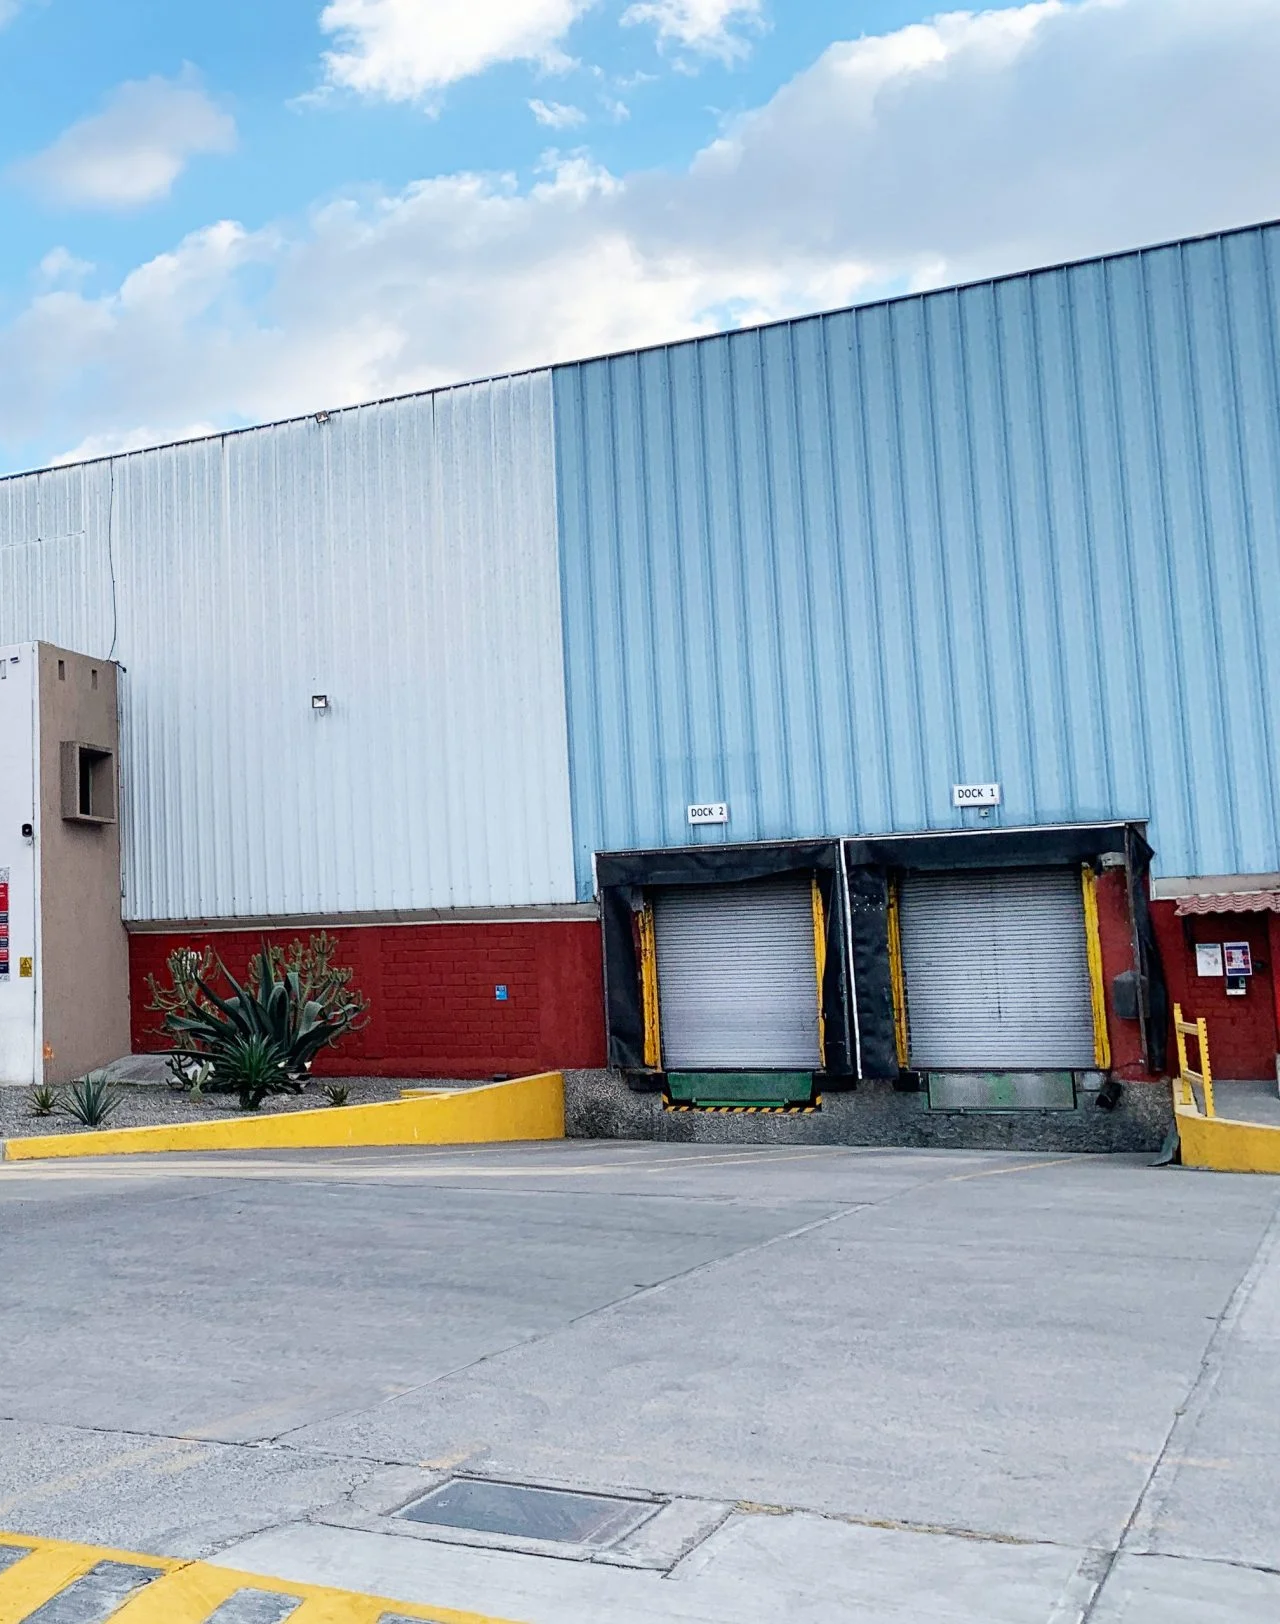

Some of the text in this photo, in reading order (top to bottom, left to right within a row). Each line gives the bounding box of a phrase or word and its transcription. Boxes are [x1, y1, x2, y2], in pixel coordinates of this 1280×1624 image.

[957, 788, 995, 798] DOCK 1
[691, 806, 724, 817] DOCK 2
